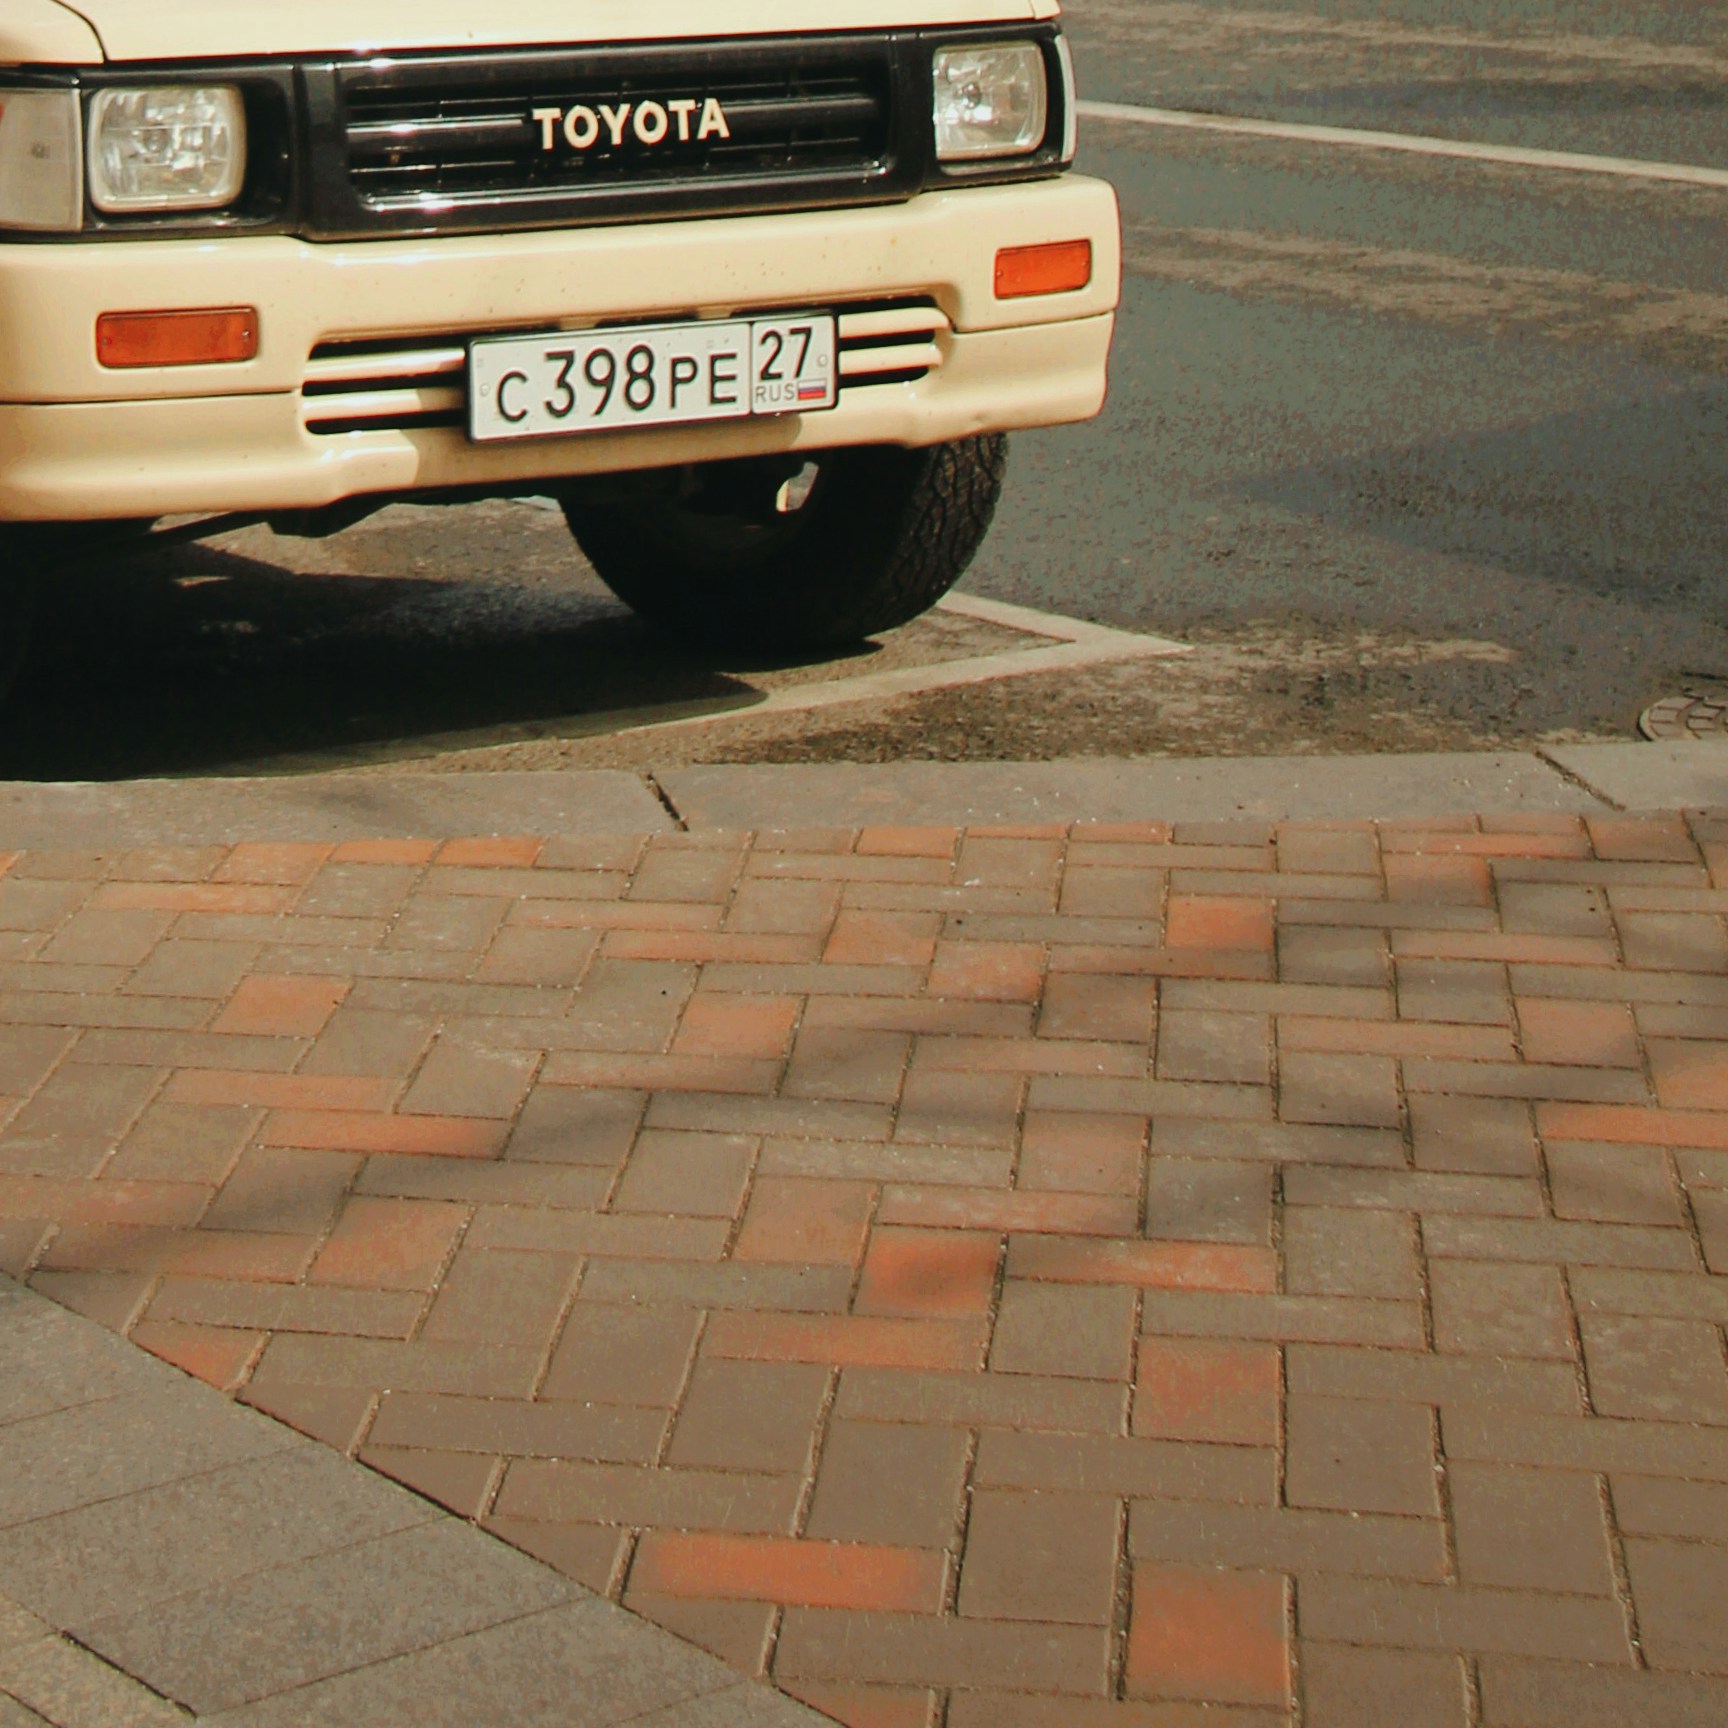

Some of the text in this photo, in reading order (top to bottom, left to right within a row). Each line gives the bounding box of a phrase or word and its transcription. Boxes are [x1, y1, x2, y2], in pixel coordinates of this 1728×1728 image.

[532, 97, 731, 151] TOYOTA
[758, 326, 813, 382] 27
[754, 382, 796, 404] RUS
